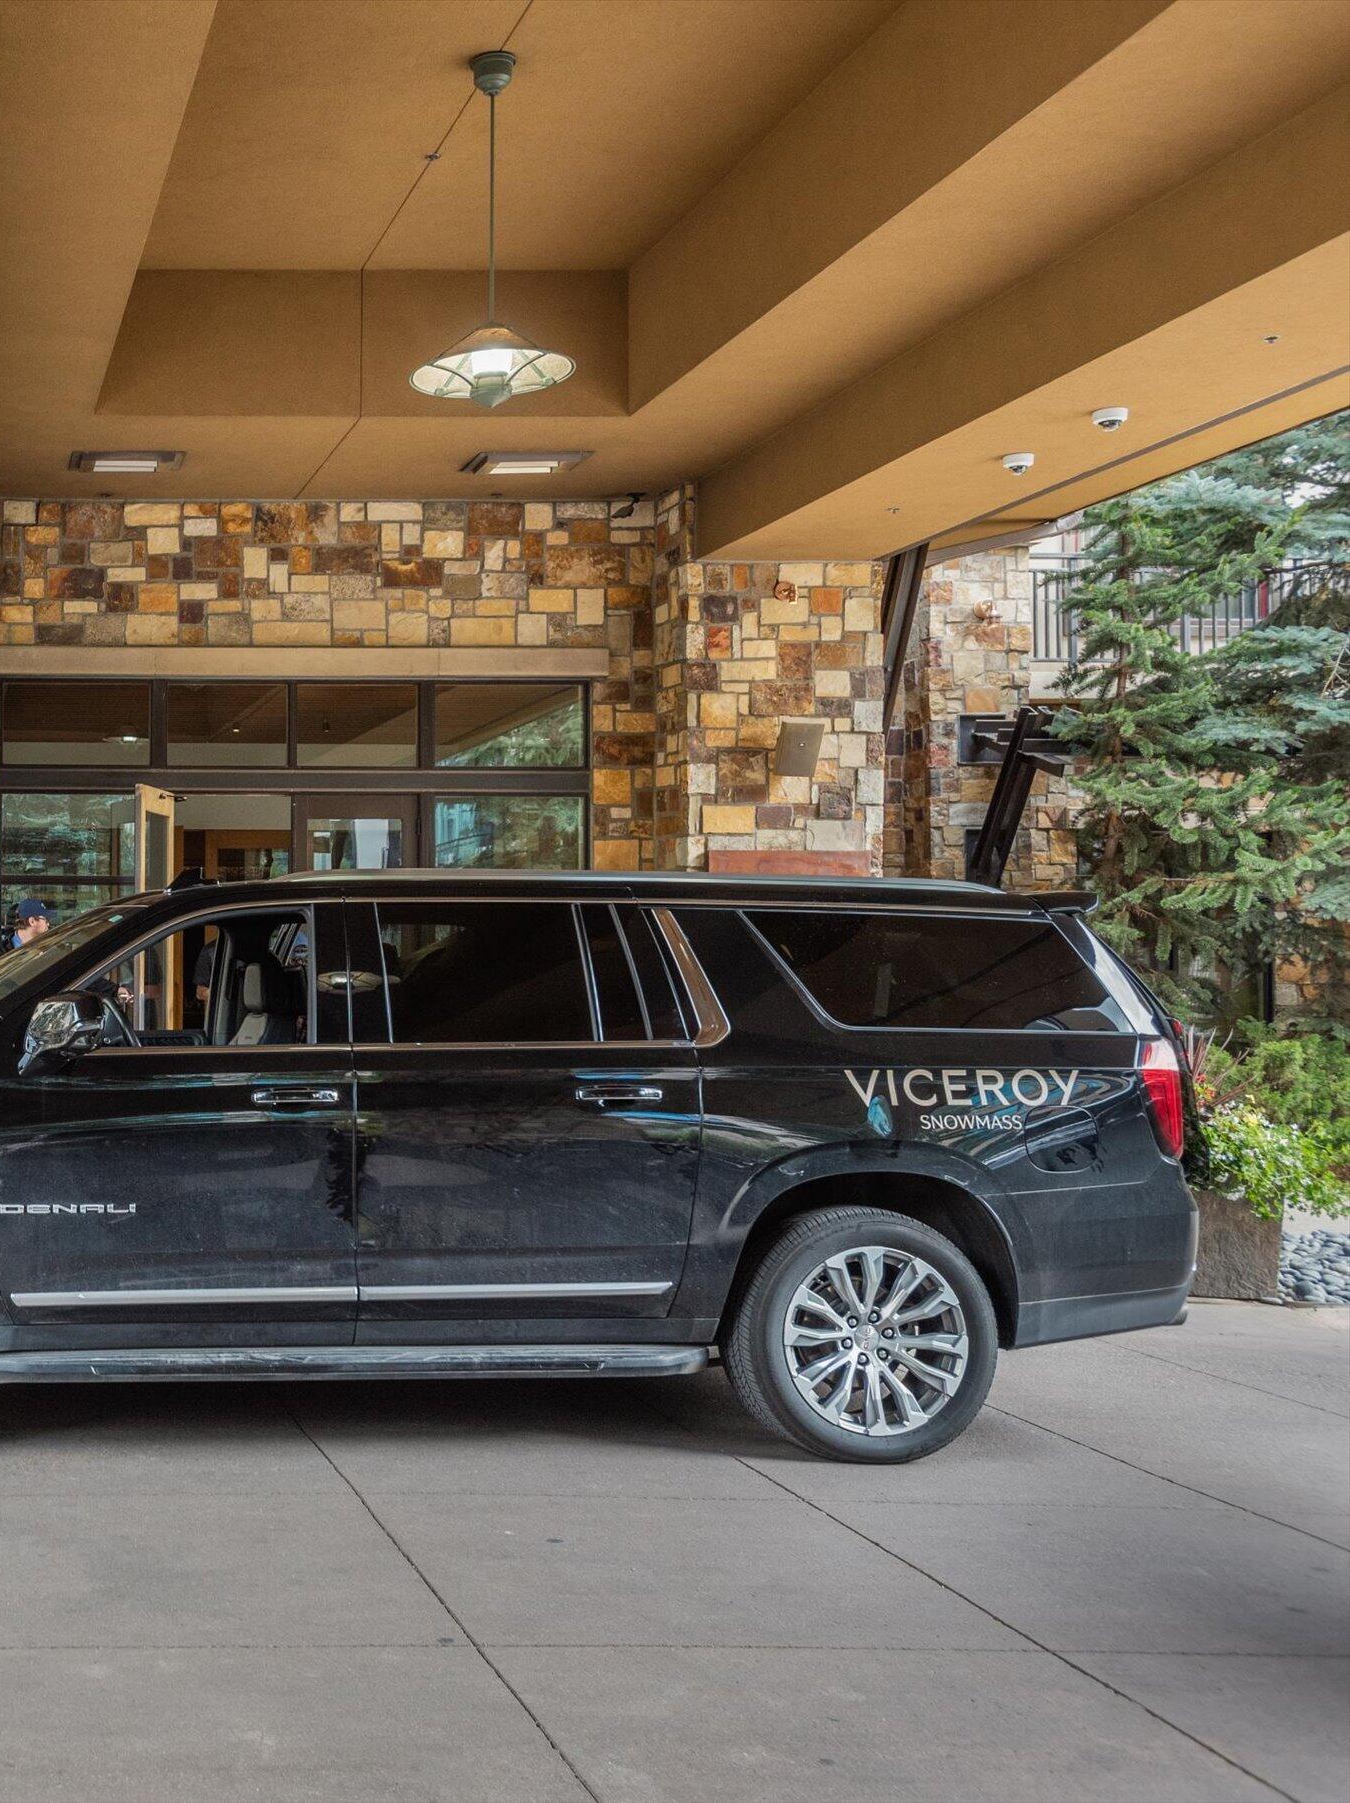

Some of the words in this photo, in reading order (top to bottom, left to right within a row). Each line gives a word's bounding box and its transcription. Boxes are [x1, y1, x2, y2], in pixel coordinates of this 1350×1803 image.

[844, 1069, 1079, 1107] VICEROY
[920, 1114, 1023, 1131] SNOWMASS
[0, 1203, 137, 1214] DENALI
[862, 1328, 872, 1350] GMC
